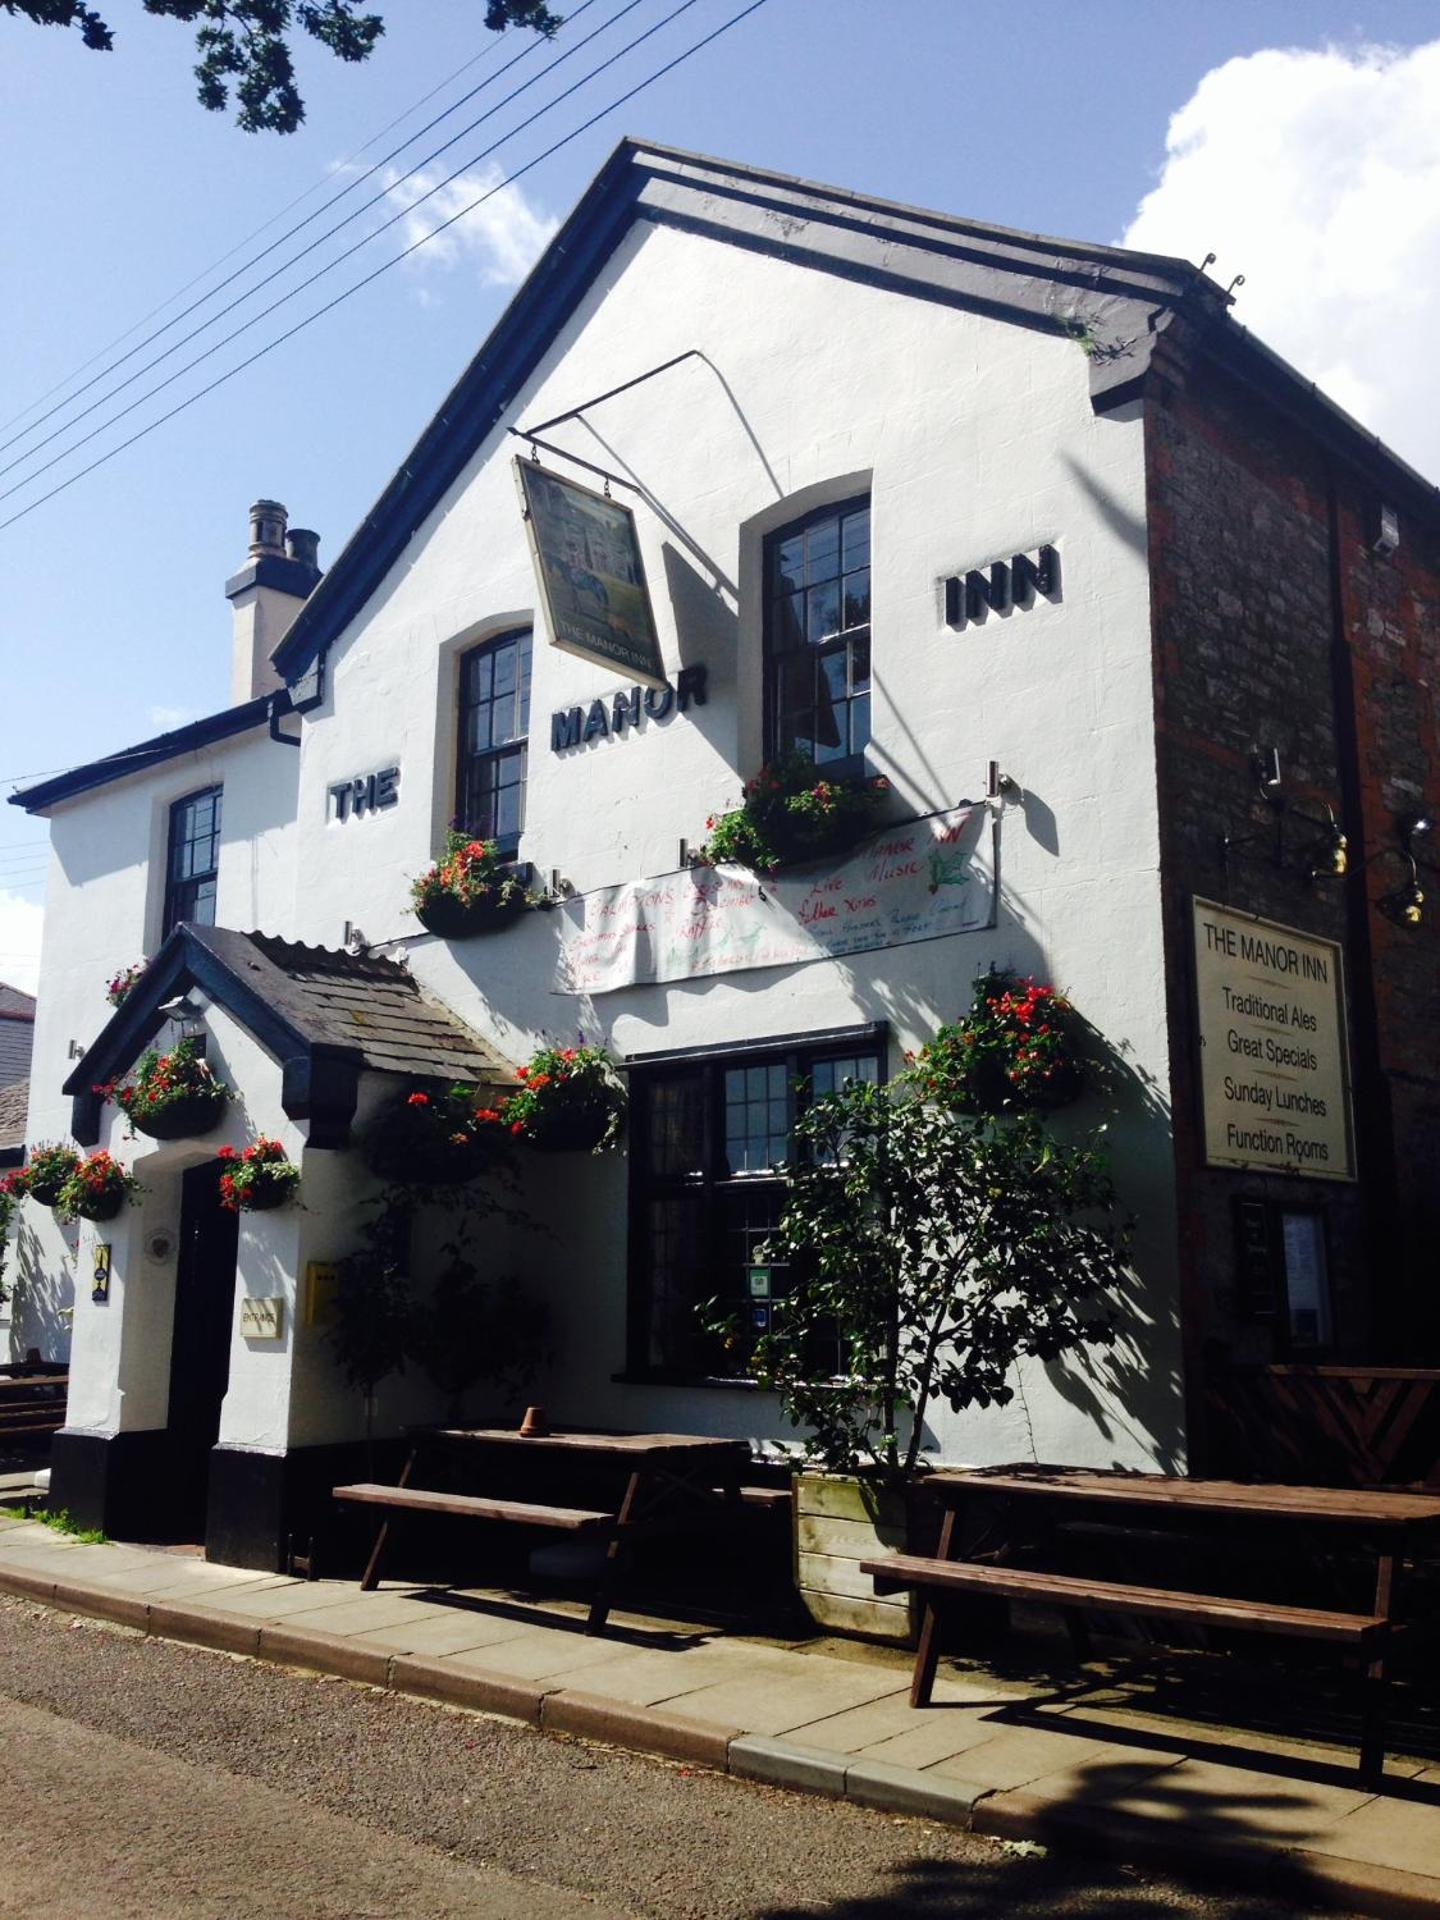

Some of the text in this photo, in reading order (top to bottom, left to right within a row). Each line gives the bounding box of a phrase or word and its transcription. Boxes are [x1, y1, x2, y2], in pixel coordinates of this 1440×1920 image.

[560, 619, 585, 641] THE
[586, 632, 631, 659] MANOR
[329, 543, 1058, 819] THE MANOR INN
[1203, 923, 1328, 983] THE MANOR INN
[1222, 986, 1316, 1031] Traditional Ales
[1228, 1029, 1317, 1070] Great Specials
[1224, 1076, 1326, 1116] Sunday Lunches
[1227, 1123, 1328, 1161] Function Rooms
